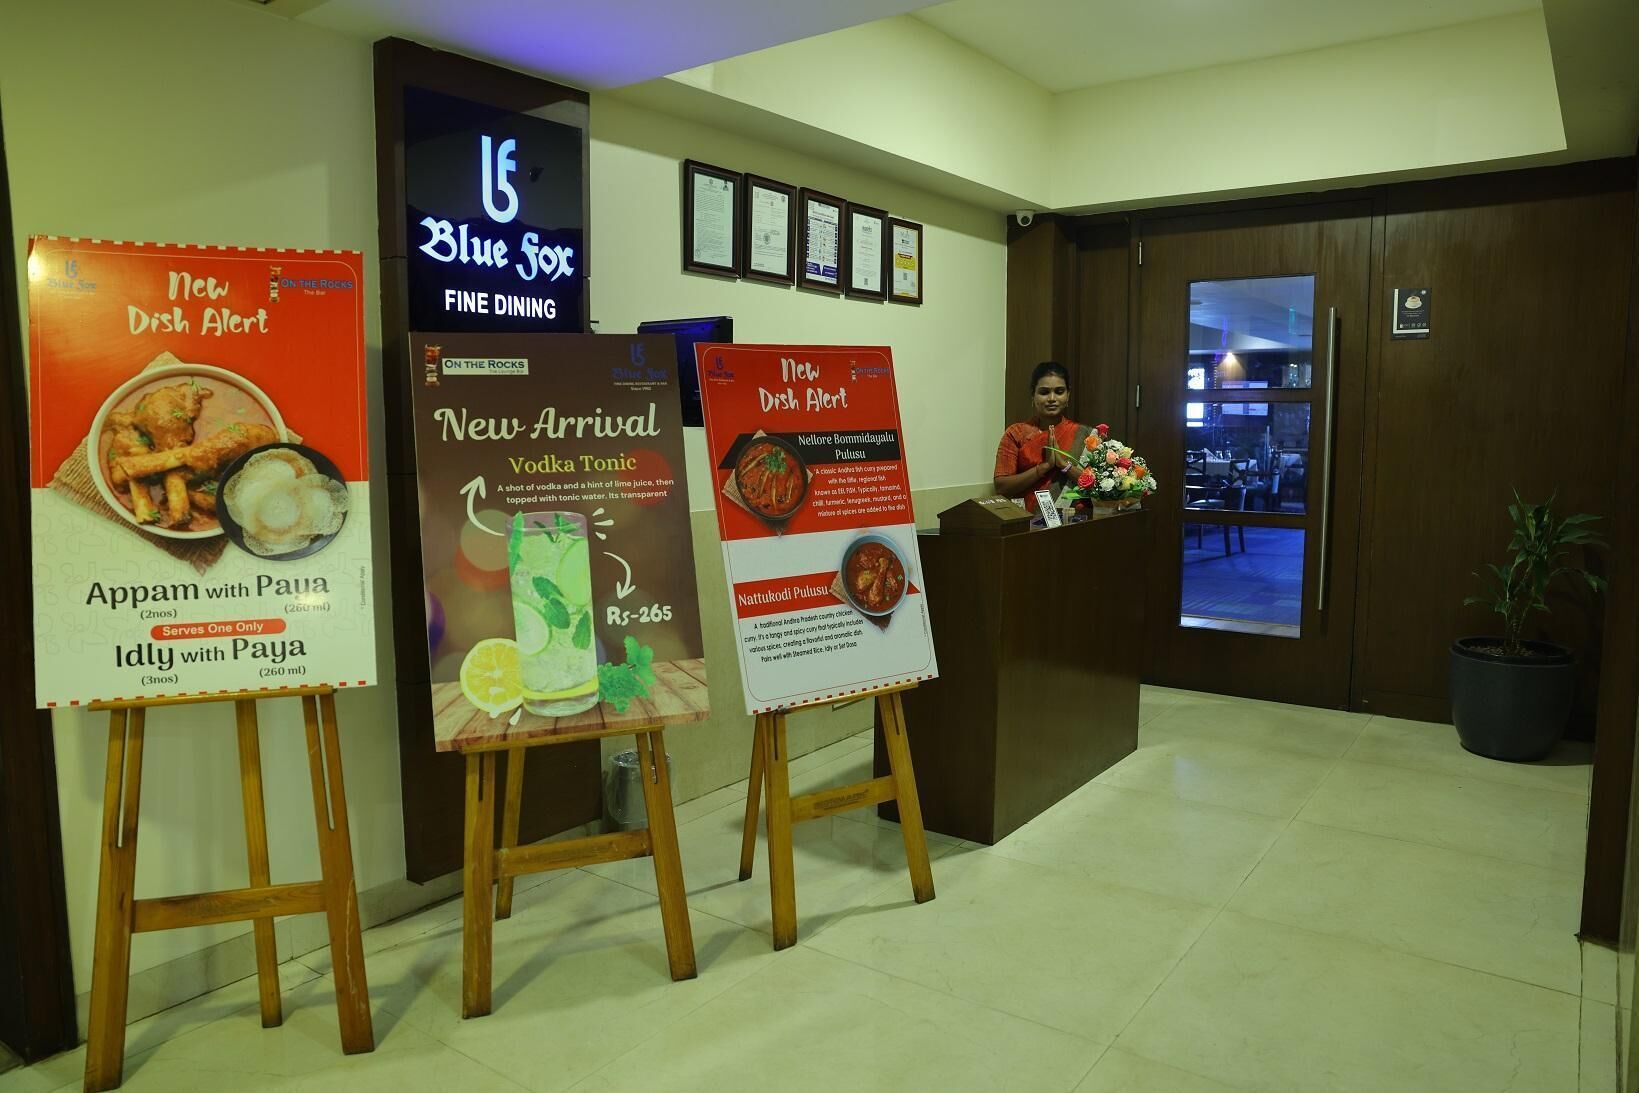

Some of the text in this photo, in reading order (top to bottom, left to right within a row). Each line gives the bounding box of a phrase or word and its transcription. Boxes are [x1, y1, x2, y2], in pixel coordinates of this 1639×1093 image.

[418, 216, 508, 269] Blue
[168, 271, 229, 300] New
[445, 289, 556, 319] FINE DINING
[127, 305, 268, 336] Dish Alert
[463, 360, 485, 369] THE
[488, 360, 525, 369] ROCKS
[780, 357, 820, 383] New
[758, 386, 848, 413] Dish Alert
[433, 403, 660, 441] New Arrival
[798, 432, 895, 446] Nellore Bommidayalu
[508, 453, 637, 474] Vodka Tonic
[835, 448, 866, 460] Pulusu
[837, 466, 854, 474] Andhra
[876, 464, 898, 472] prepared
[505, 484, 524, 492] shot
[525, 483, 535, 491] of
[536, 482, 561, 491] vodka
[563, 482, 579, 490] and
[587, 481, 603, 489] hint
[604, 480, 614, 488] of
[614, 480, 632, 488] lime
[633, 479, 655, 489] juice,
[656, 478, 674, 486] then
[859, 476, 878, 484] regional
[506, 495, 537, 505] topped
[539, 494, 557, 502] with
[559, 493, 580, 501] tonic
[620, 490, 667, 500] transparent
[86, 581, 199, 610] Appam
[205, 582, 249, 599] with
[738, 585, 828, 606] Nattukodi Pulusu
[140, 608, 177, 620] (2nos)
[606, 603, 672, 626] Rs-265
[759, 619, 783, 629] traditional
[783, 617, 800, 625] Andhra
[800, 614, 818, 623] Pradesh
[819, 611, 835, 620] country
[835, 609, 853, 618] chicken
[162, 621, 264, 637] Serves One Only
[770, 631, 783, 640] tangy
[783, 629, 793, 637] and
[793, 628, 806, 637] spicy
[806, 626, 818, 634] curry
[828, 621, 845, 631] typically
[846, 619, 864, 627] includes
[749, 645, 766, 653] various
[782, 639, 802, 648] creating
[833, 632, 853, 640] aromatic
[115, 637, 307, 671] Idly with Paya
[761, 654, 772, 663] Pairs
[773, 653, 782, 661] well
[783, 651, 792, 659] with
[792, 648, 812, 658] Steamed
[825, 645, 833, 653] Idly
[141, 674, 178, 687] (3nos)
[259, 665, 306, 678] (260 ml)
